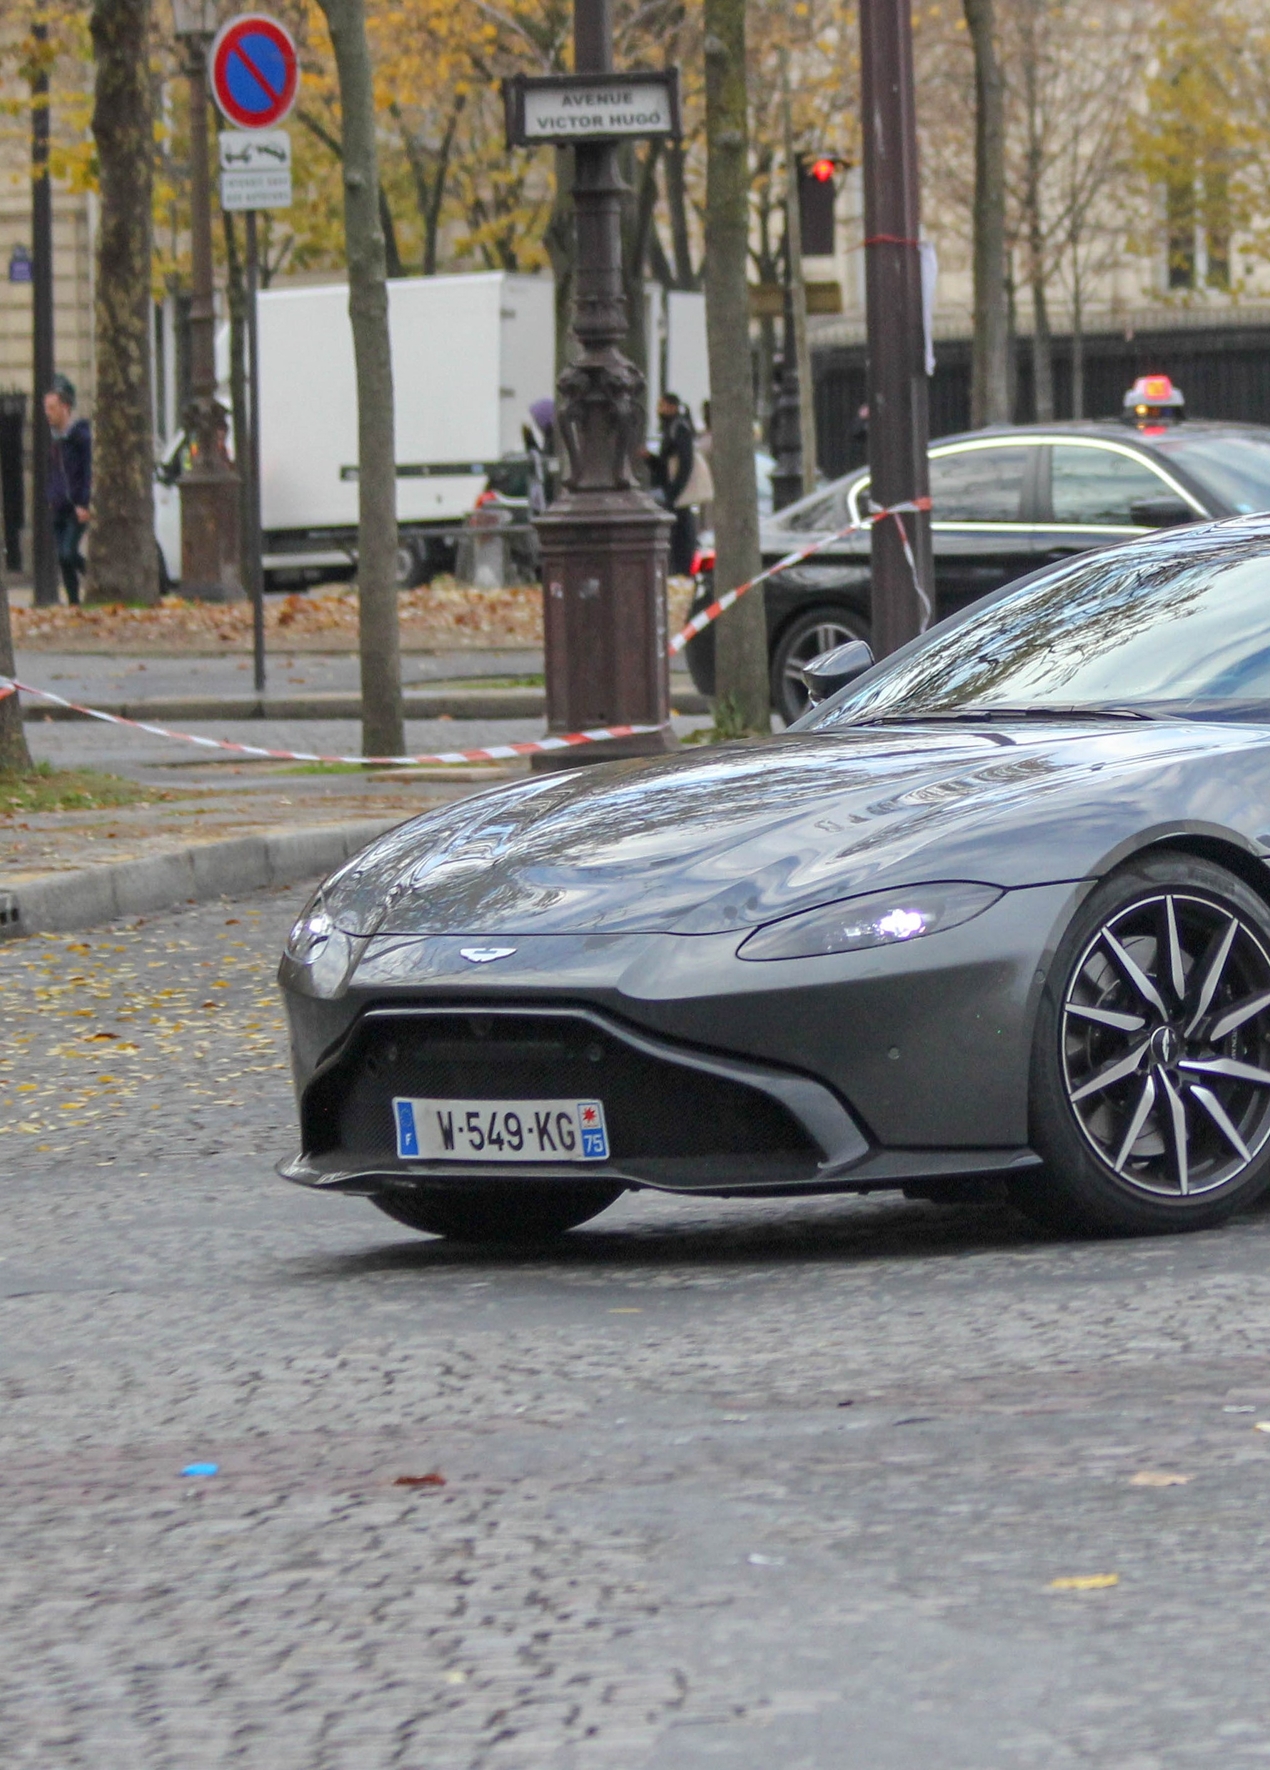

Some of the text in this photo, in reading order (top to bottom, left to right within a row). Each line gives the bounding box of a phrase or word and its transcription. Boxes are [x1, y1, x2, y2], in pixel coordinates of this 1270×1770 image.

[561, 92, 633, 107] AVENUE
[537, 112, 661, 129] VICTOR HUGO
[405, 1132, 412, 1146] F
[583, 1134, 604, 1153] 75
